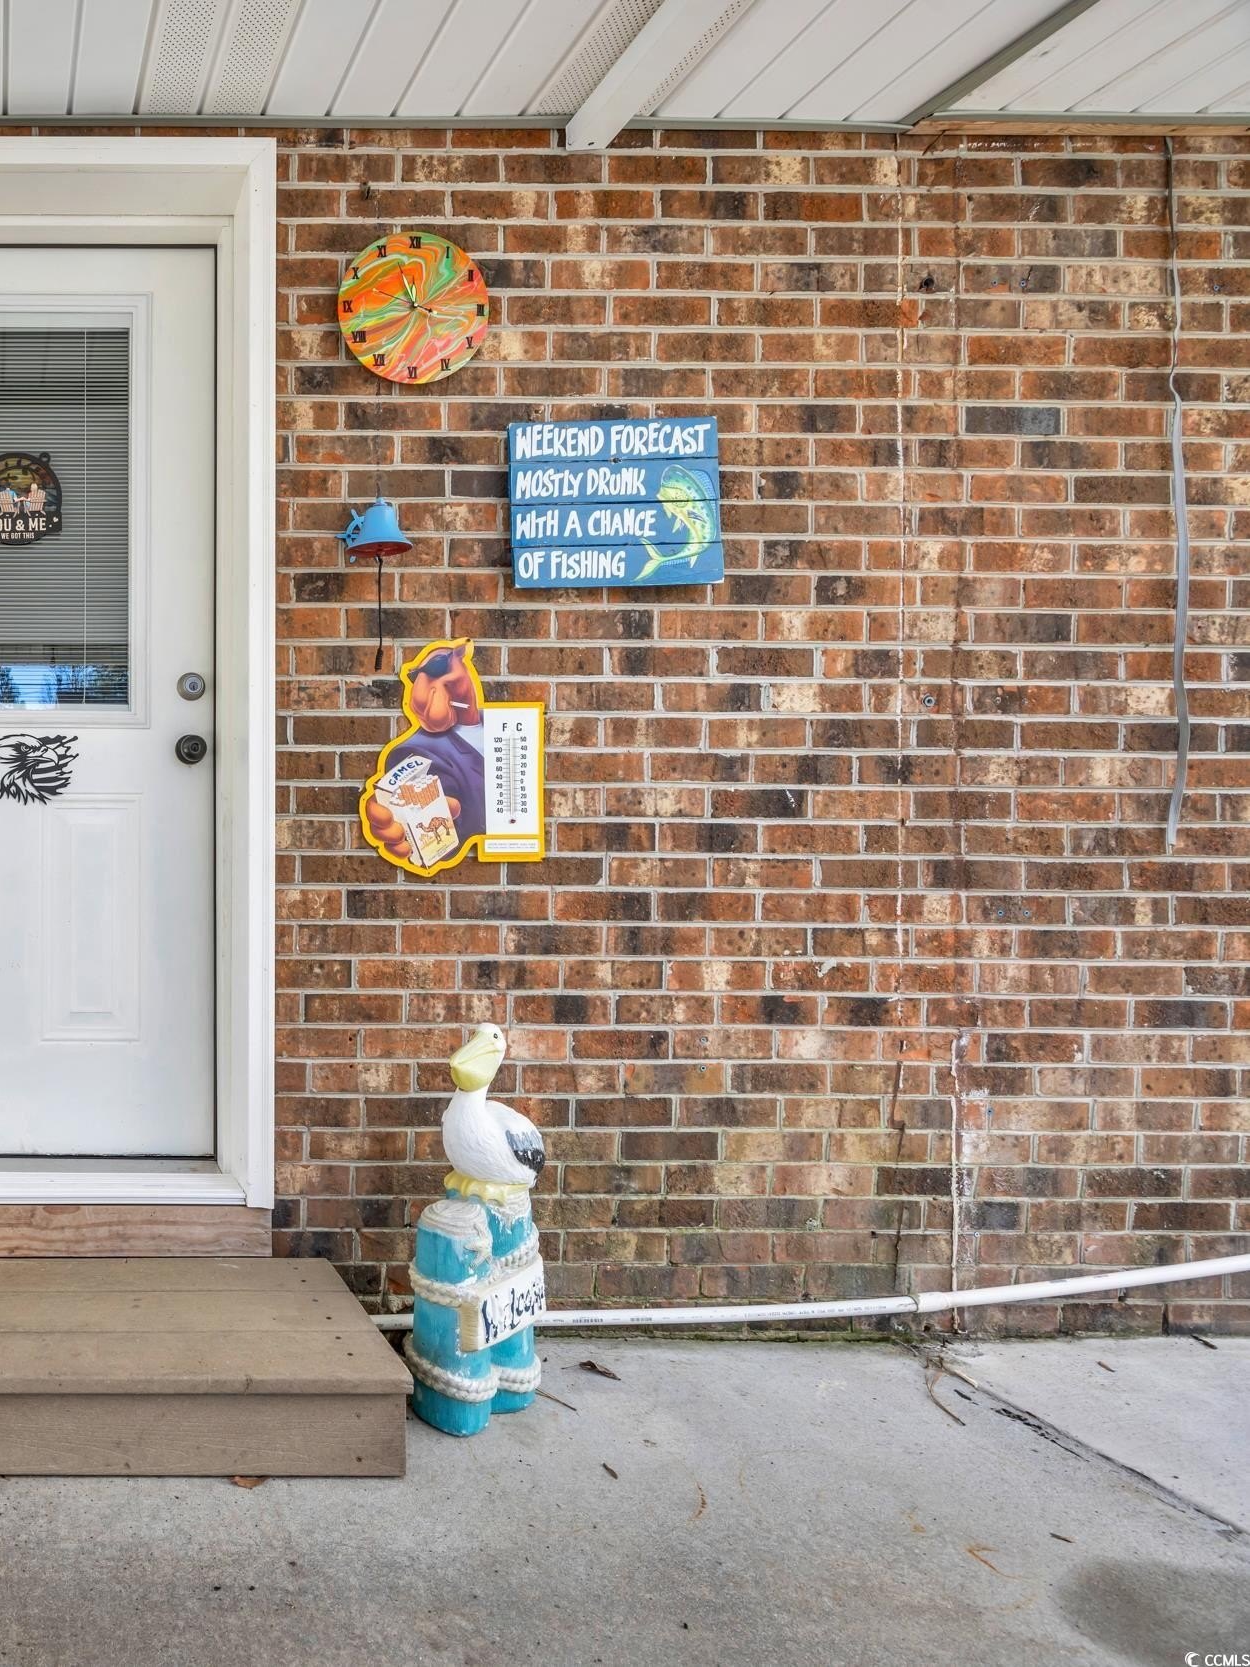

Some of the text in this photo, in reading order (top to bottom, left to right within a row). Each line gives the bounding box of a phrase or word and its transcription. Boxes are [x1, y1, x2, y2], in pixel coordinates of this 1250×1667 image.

[409, 236, 422, 249] XII
[377, 245, 387, 258] XI
[445, 246, 450, 259] I
[352, 267, 360, 280] X
[467, 270, 474, 282] II
[342, 300, 353, 313] IX
[476, 304, 485, 317] III
[466, 336, 473, 349] V
[373, 354, 386, 367] VII
[440, 358, 451, 371] IV
[407, 366, 418, 379] VI
[515, 422, 711, 460] WEEKEND FORECAST
[516, 467, 647, 499] MOSTLY DRUNK
[15, 519, 25, 531] &
[28, 518, 47, 531] ME
[515, 509, 657, 539] WITH A CHANCE
[518, 550, 625, 581] OF FISHING
[502, 722, 523, 732] F C
[388, 759, 424, 786] CAMEL
